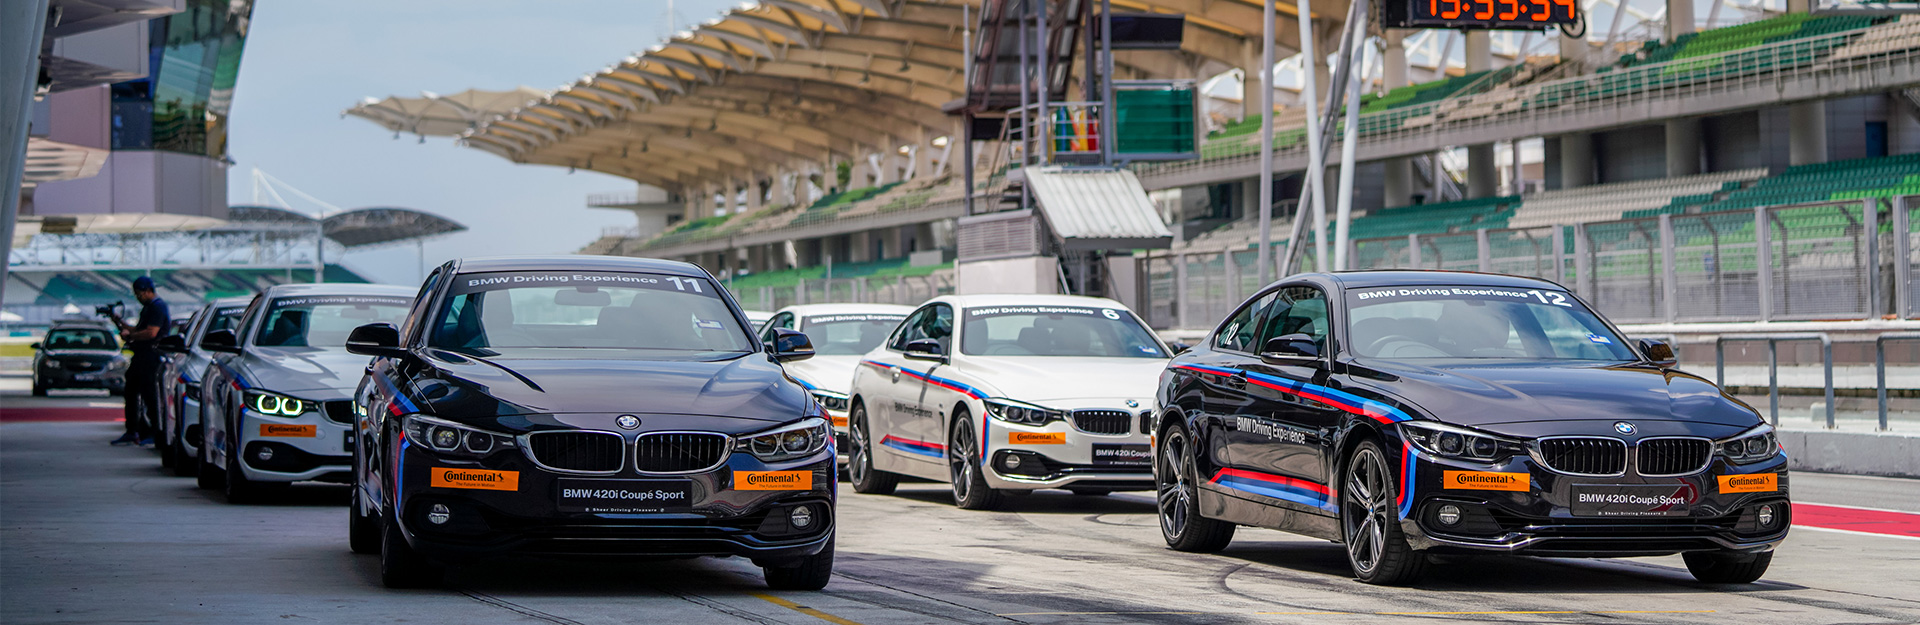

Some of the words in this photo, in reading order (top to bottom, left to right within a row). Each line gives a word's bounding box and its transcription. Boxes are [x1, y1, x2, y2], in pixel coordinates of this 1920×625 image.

[468, 276, 510, 287] BMW
[513, 274, 569, 283] Driving
[572, 274, 658, 284] Experience
[665, 276, 703, 293] 11
[276, 298, 306, 307] BMW
[348, 297, 407, 305] Experience
[1358, 290, 1396, 300] BMW
[1399, 288, 1451, 297] Driving
[1451, 288, 1528, 298] Experience
[1528, 289, 1572, 308] 12
[971, 308, 1000, 316] BMW
[1038, 307, 1094, 315] Experience
[1102, 308, 1121, 320] 6
[811, 316, 835, 324] BMW
[1224, 322, 1239, 346] 12
[268, 425, 302, 433] Continental
[1236, 416, 1252, 433] BMW
[1252, 419, 1272, 439] Driving
[1272, 422, 1306, 444] Experience
[1017, 433, 1052, 441] Continental
[444, 470, 496, 482] Continental
[746, 473, 794, 485] Continental
[1456, 473, 1508, 485] Continental
[1729, 476, 1765, 488] Continental
[563, 489, 592, 499] BMW
[593, 489, 619, 499] 420i
[620, 489, 654, 501] Coupé
[655, 490, 685, 501] Sport
[1579, 493, 1605, 503] BMW
[1606, 493, 1628, 503] 420i
[1629, 494, 1658, 506] Coupé
[1659, 495, 1684, 506] Sport
